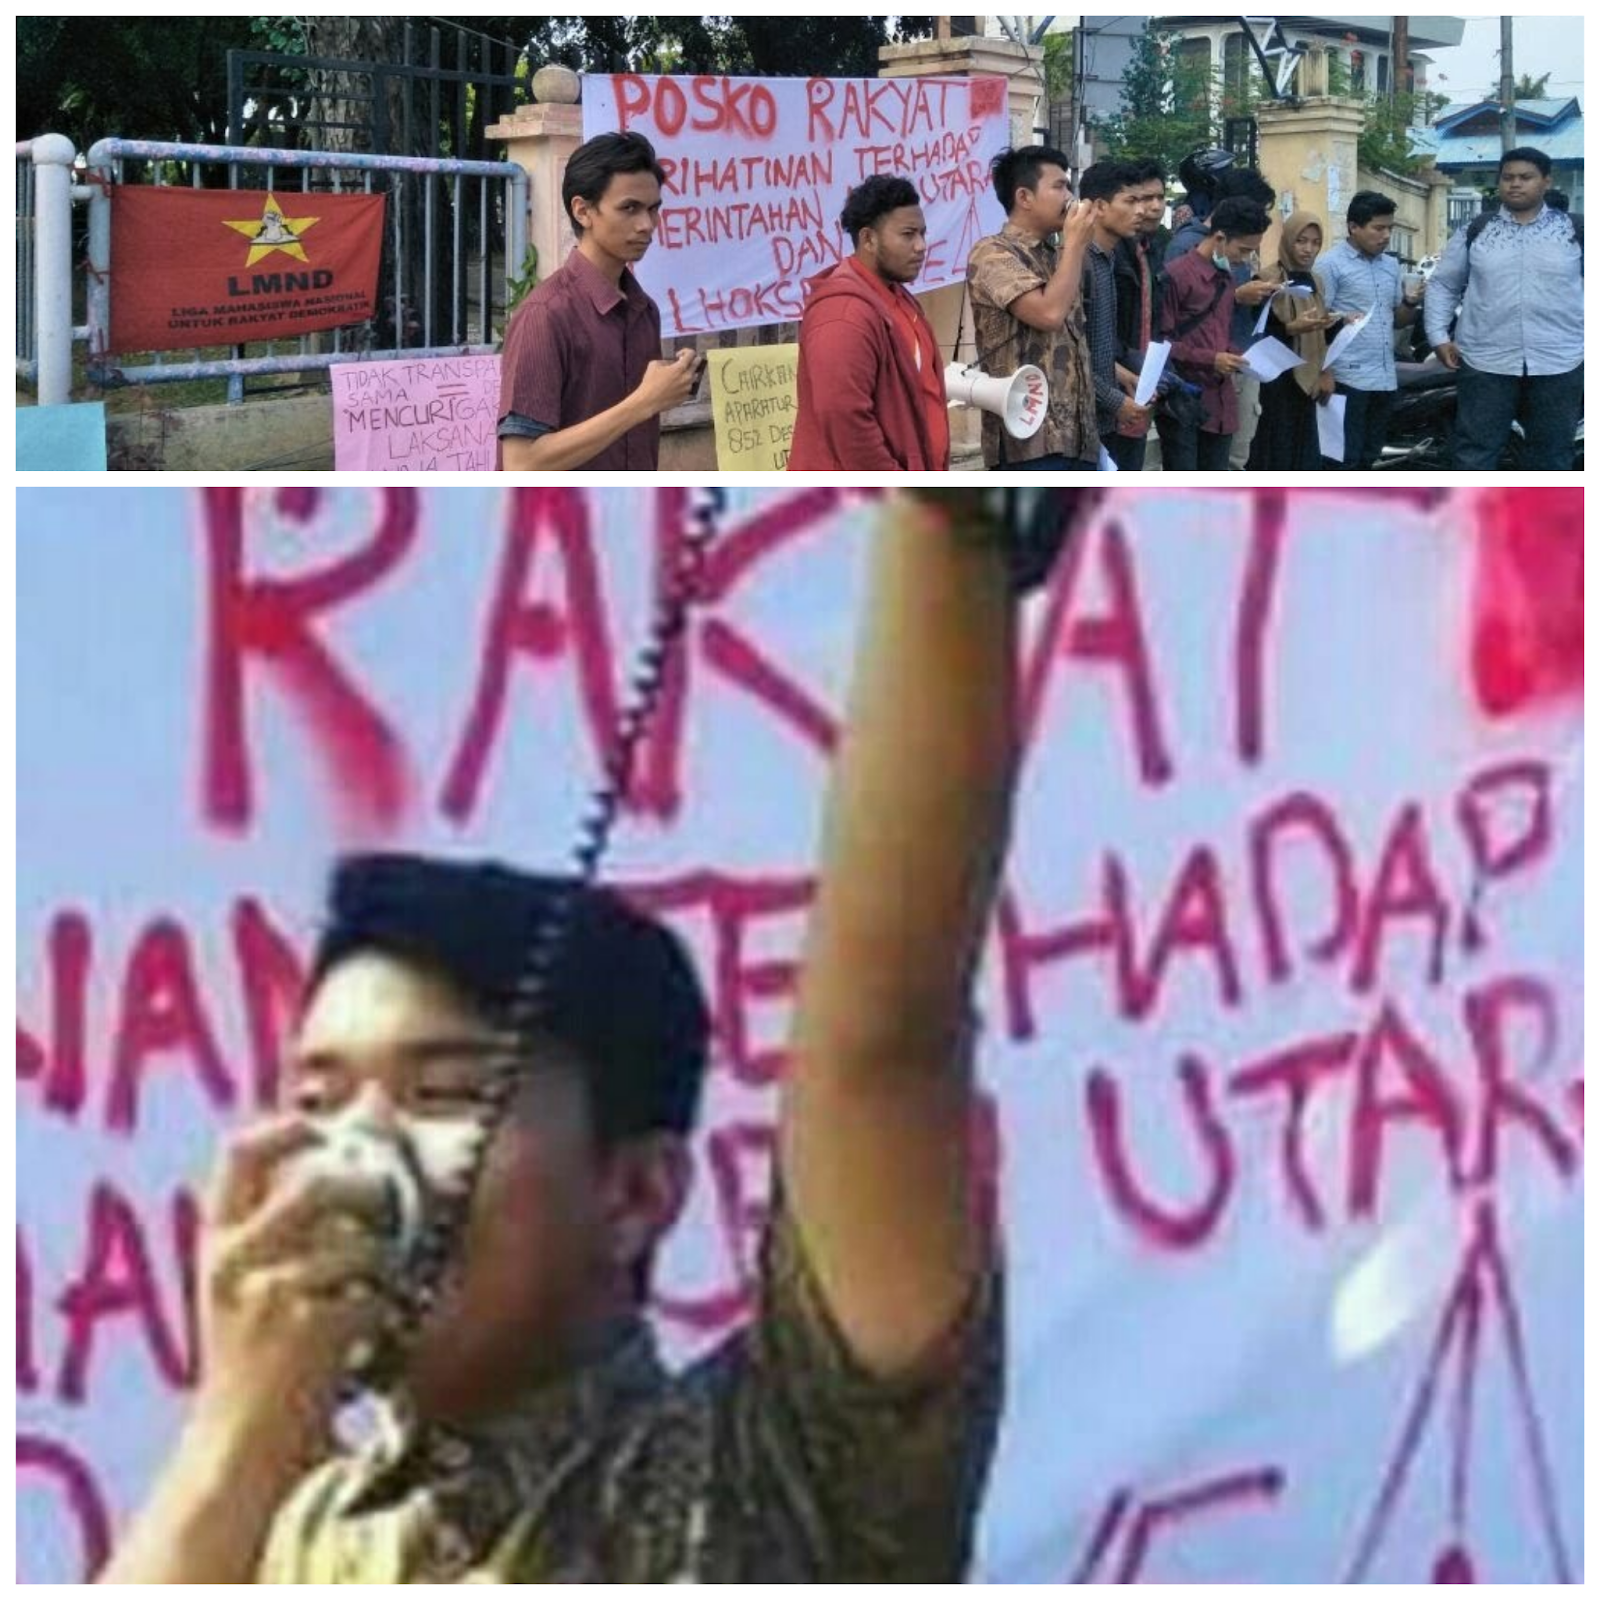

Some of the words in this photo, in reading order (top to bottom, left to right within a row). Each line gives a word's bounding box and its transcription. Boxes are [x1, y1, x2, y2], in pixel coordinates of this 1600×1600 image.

[611, 73, 777, 139] POSKO
[806, 76, 968, 143] RAKYAT
[772, 220, 843, 276] DAN
[228, 269, 334, 297] LMND
[168, 317, 228, 329] UNTUK
[228, 311, 287, 326] RAKYAT
[171, 307, 208, 317] LIGA
[341, 367, 398, 389] TIDAK
[347, 388, 408, 408] SAMA
[1019, 373, 1044, 426] LMND
[727, 427, 763, 454] 852
